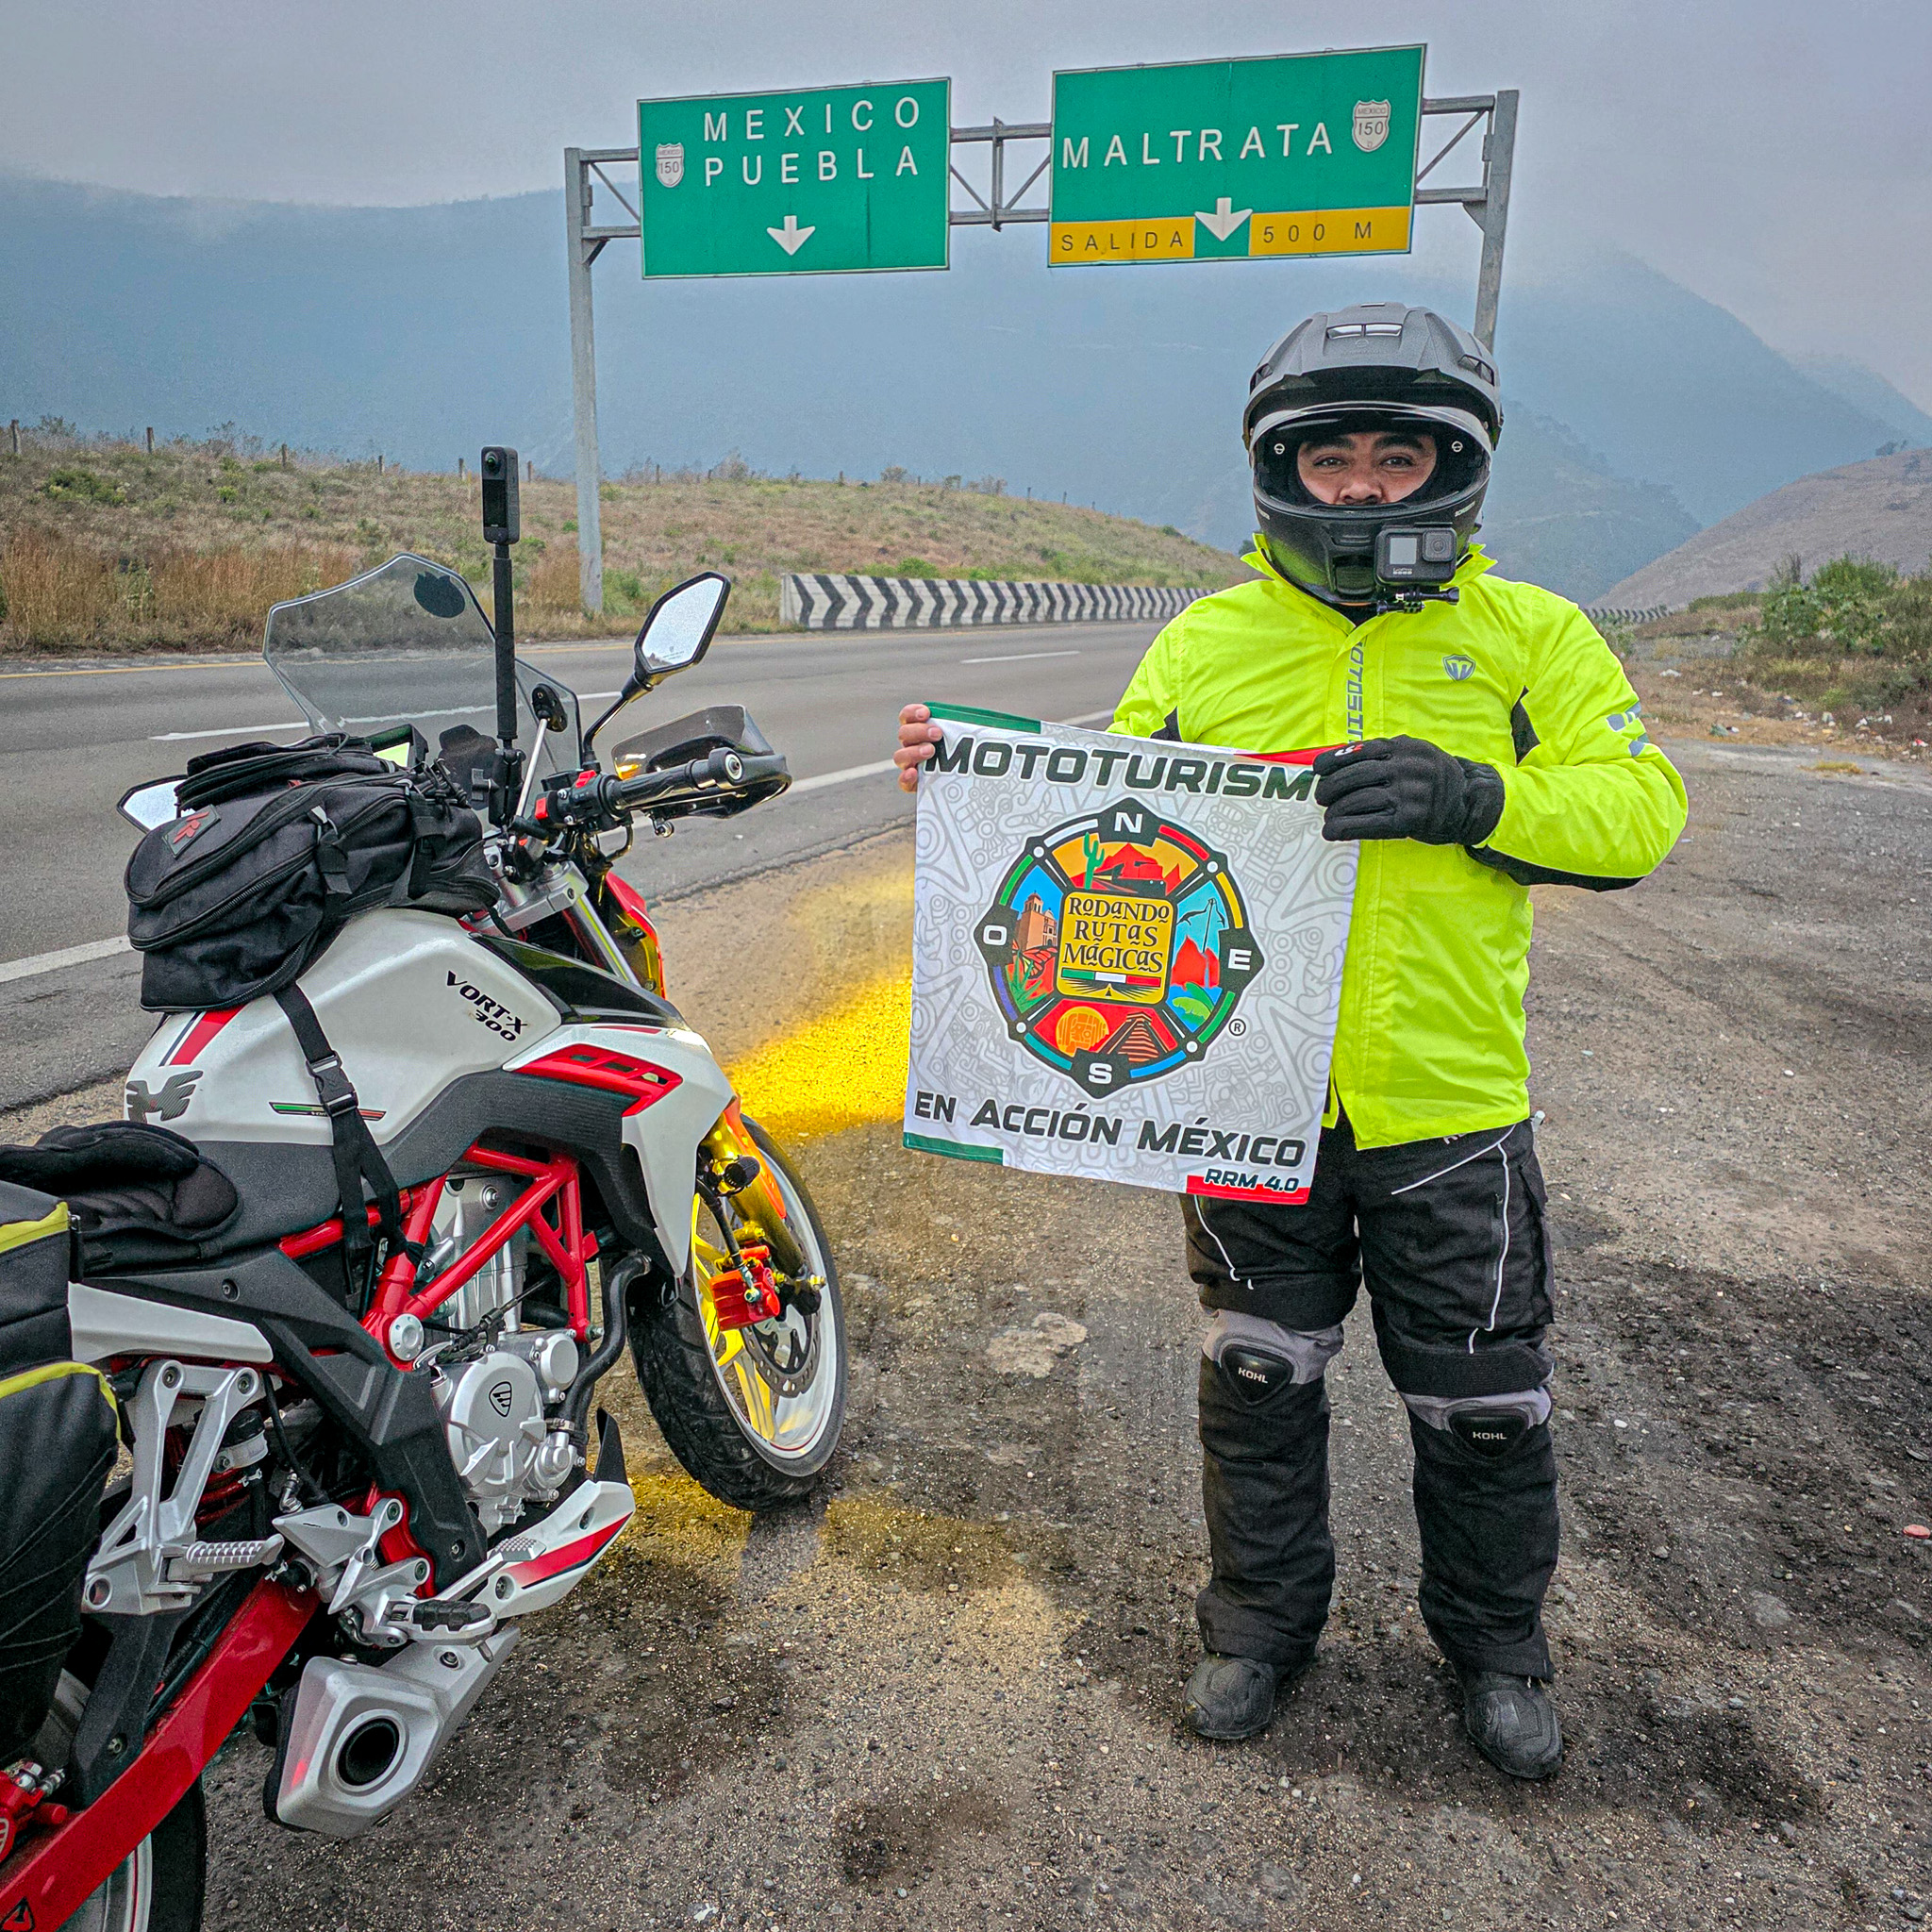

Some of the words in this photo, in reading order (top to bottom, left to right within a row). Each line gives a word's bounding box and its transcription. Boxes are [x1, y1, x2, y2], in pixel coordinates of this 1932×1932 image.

[704, 97, 919, 142] MEXICO
[1358, 121, 1384, 135] 150
[1062, 123, 1332, 169] MALTRATA
[659, 161, 679, 174] 150
[705, 145, 918, 187] PUEBLA
[1061, 230, 1183, 251] SALIDA
[1263, 224, 1325, 243] 500
[1354, 222, 1372, 239] M
[924, 737, 1323, 805] MOTOTURISM
[1114, 811, 1142, 833] N
[1228, 949, 1251, 970] E
[447, 970, 527, 1035] VORT-X
[475, 1009, 516, 1041] 300
[1088, 1062, 1112, 1084] S
[914, 1091, 957, 1123] EN
[970, 1103, 1122, 1145] ACCIÓN
[1137, 1118, 1306, 1167] MÉXICO
[1205, 1168, 1258, 1189] RRM
[1264, 1175, 1299, 1191] 4.0
[1238, 1366, 1269, 1385] KOHL
[1473, 1430, 1507, 1441] KOHL
